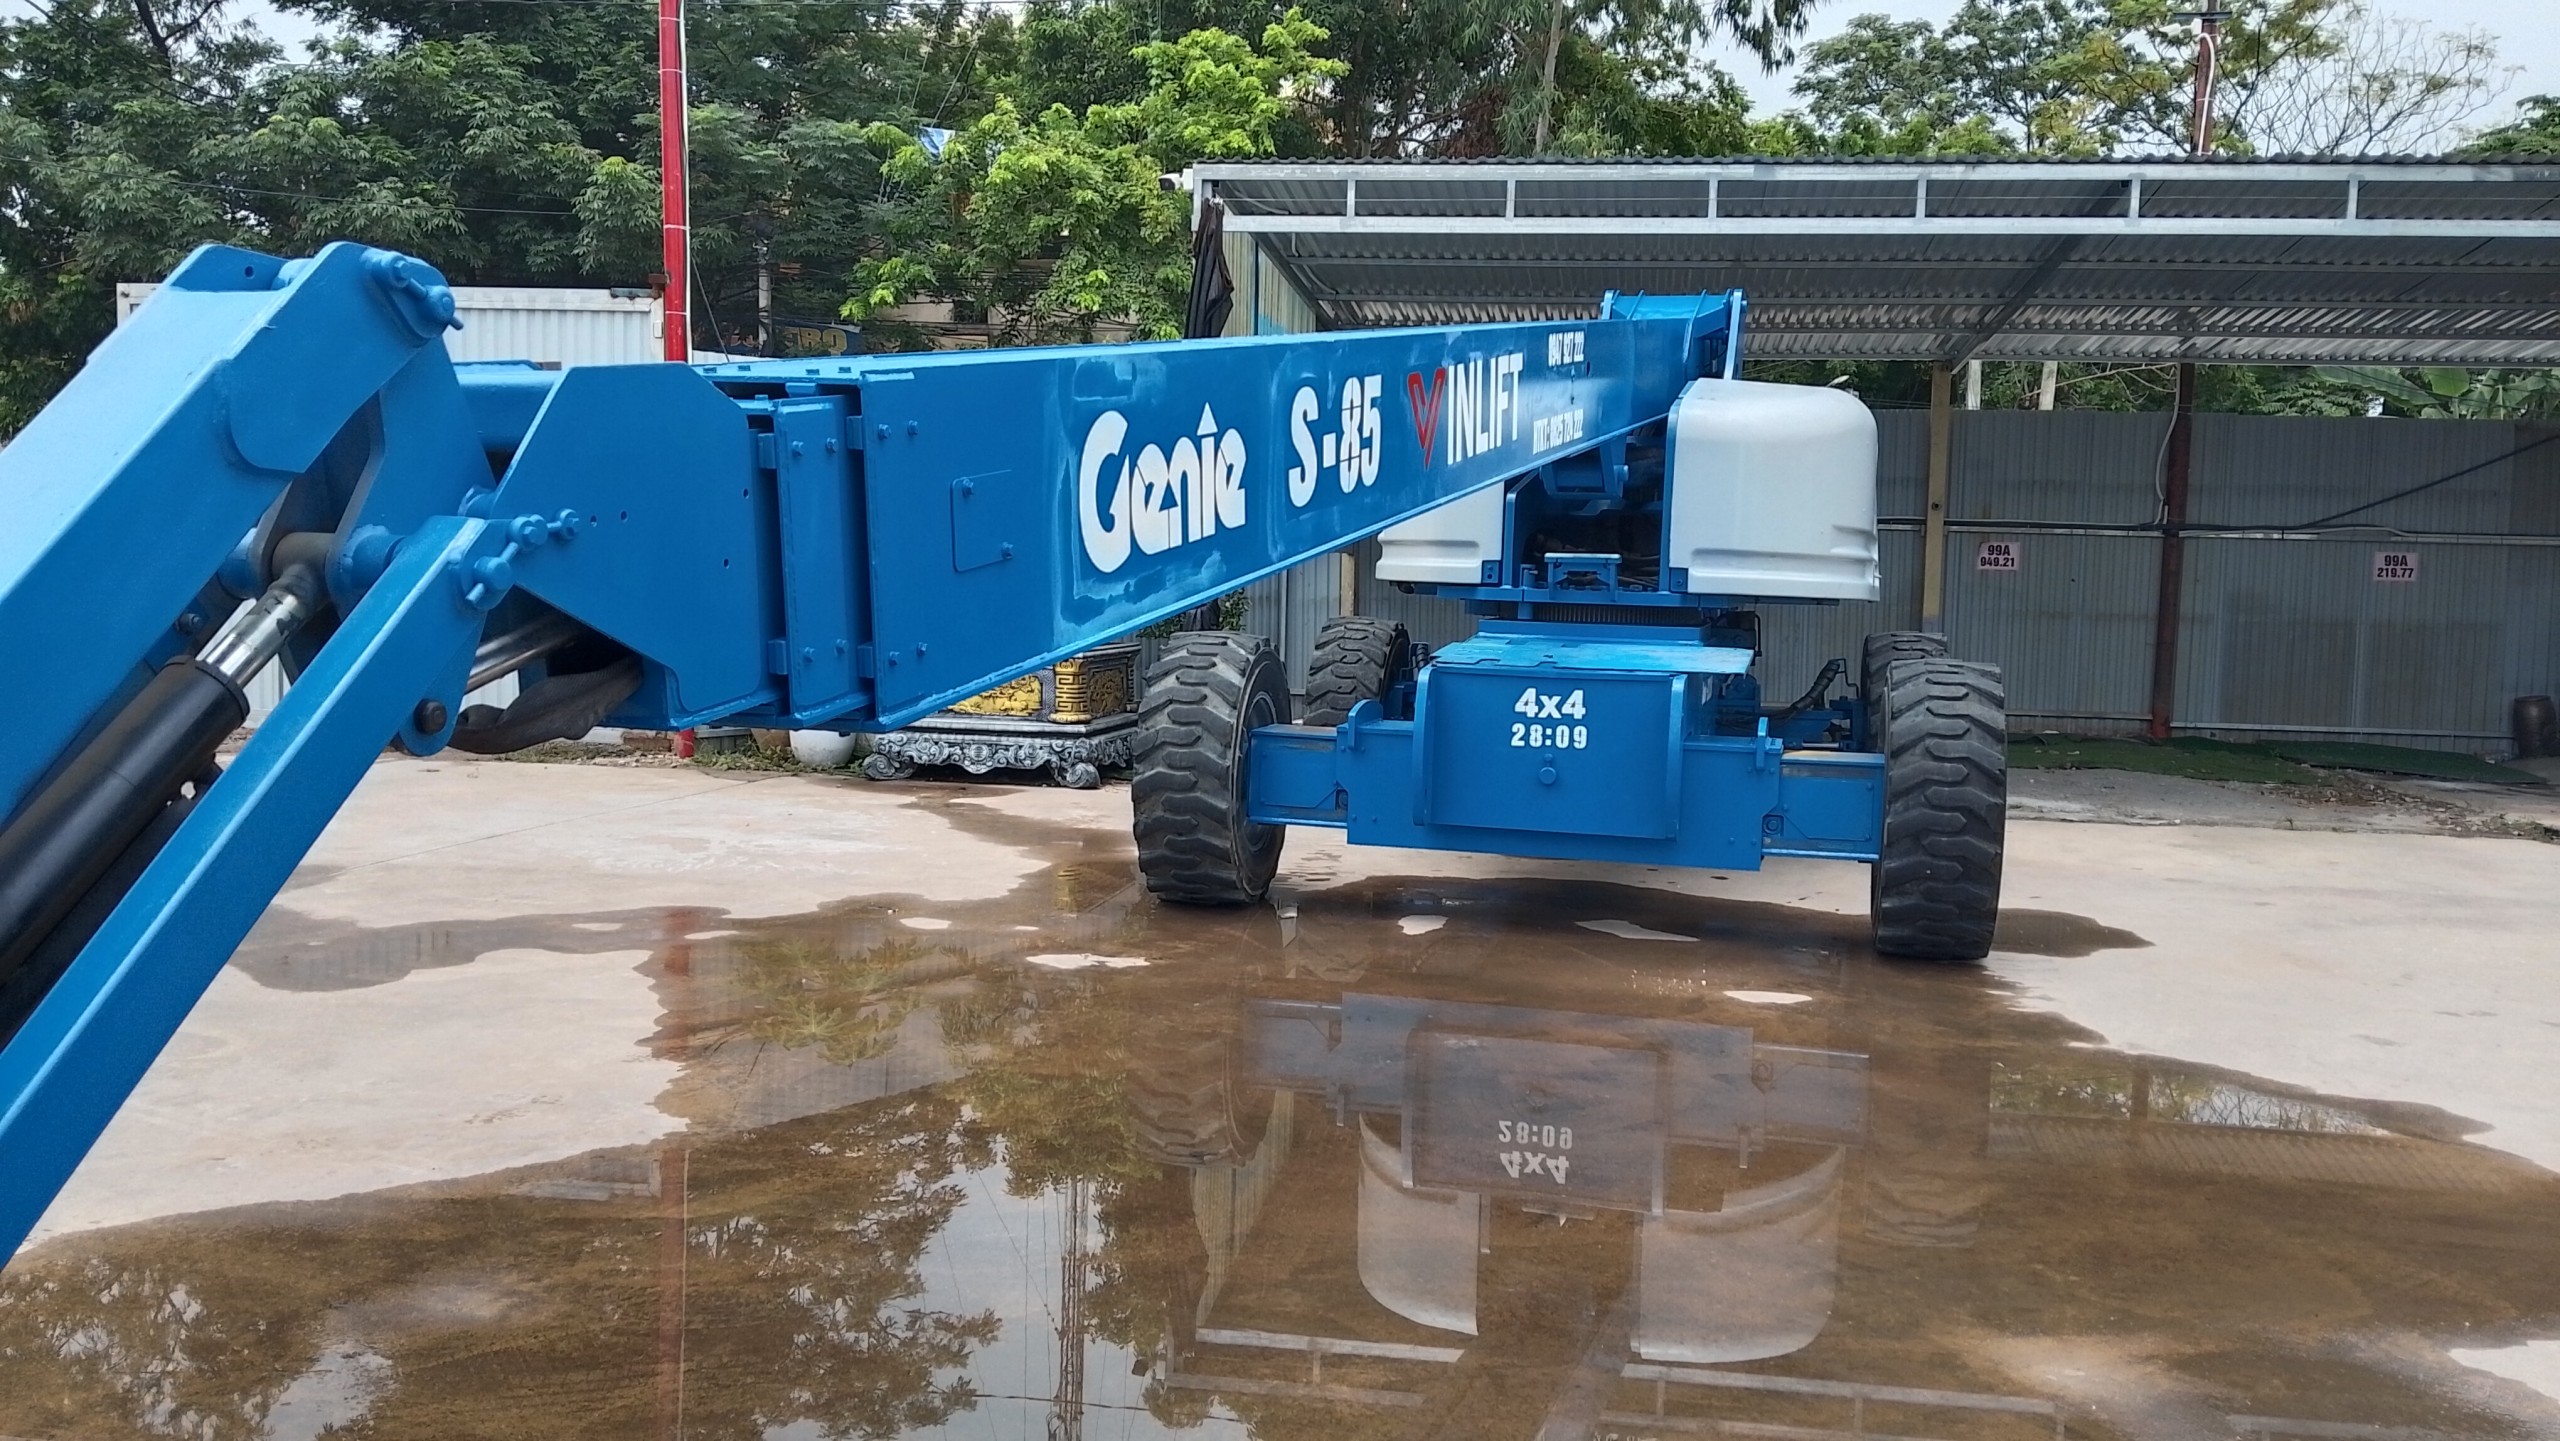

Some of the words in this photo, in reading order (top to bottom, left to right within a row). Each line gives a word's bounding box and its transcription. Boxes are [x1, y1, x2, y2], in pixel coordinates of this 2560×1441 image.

[1573, 330, 1585, 362] 222
[1573, 407, 1584, 440] 222
[1080, 402, 1247, 573] Genie
[1288, 374, 1382, 508] S-85
[1980, 556, 2015, 567] 949.21
[1987, 544, 2010, 556] 99A
[2384, 554, 2408, 567] 99A
[2377, 567, 2414, 578] 219.77
[1514, 687, 1586, 720] 4x4
[1510, 722, 1588, 749] 28:09
